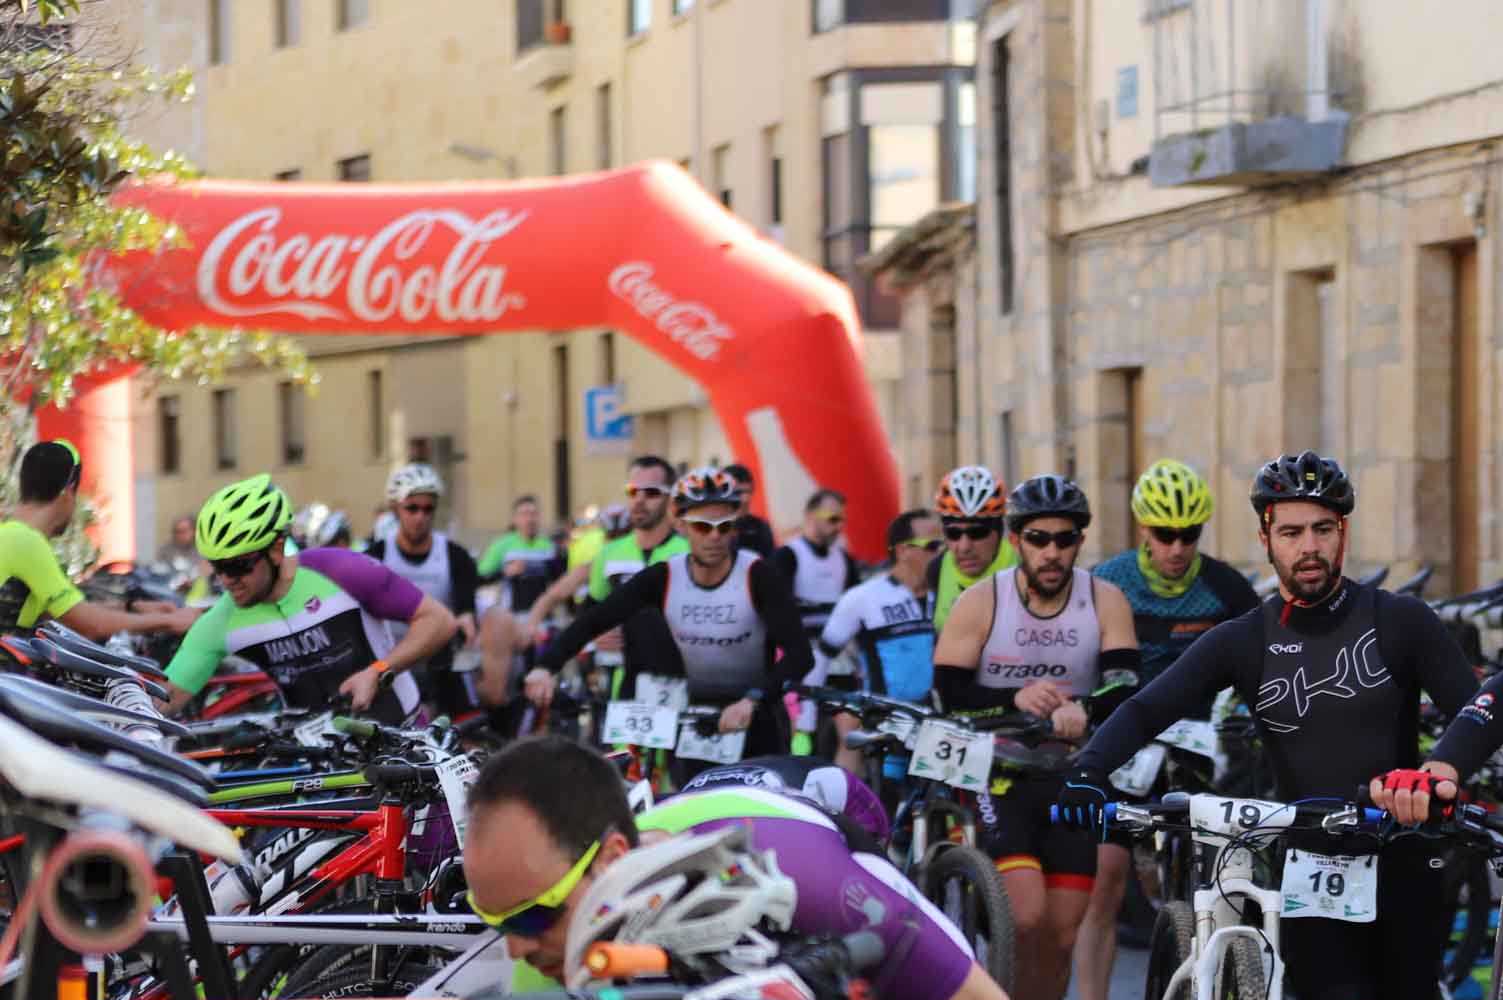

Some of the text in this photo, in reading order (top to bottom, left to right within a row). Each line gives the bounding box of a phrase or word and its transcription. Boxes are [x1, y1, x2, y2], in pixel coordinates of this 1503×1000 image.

[681, 604, 738, 625] PEREZ
[1015, 628, 1079, 648] CASAS
[986, 663, 1067, 679] 37300
[625, 718, 654, 733] 33
[935, 741, 967, 766] 31
[1219, 801, 1261, 828] 19
[1309, 870, 1345, 897] 19
